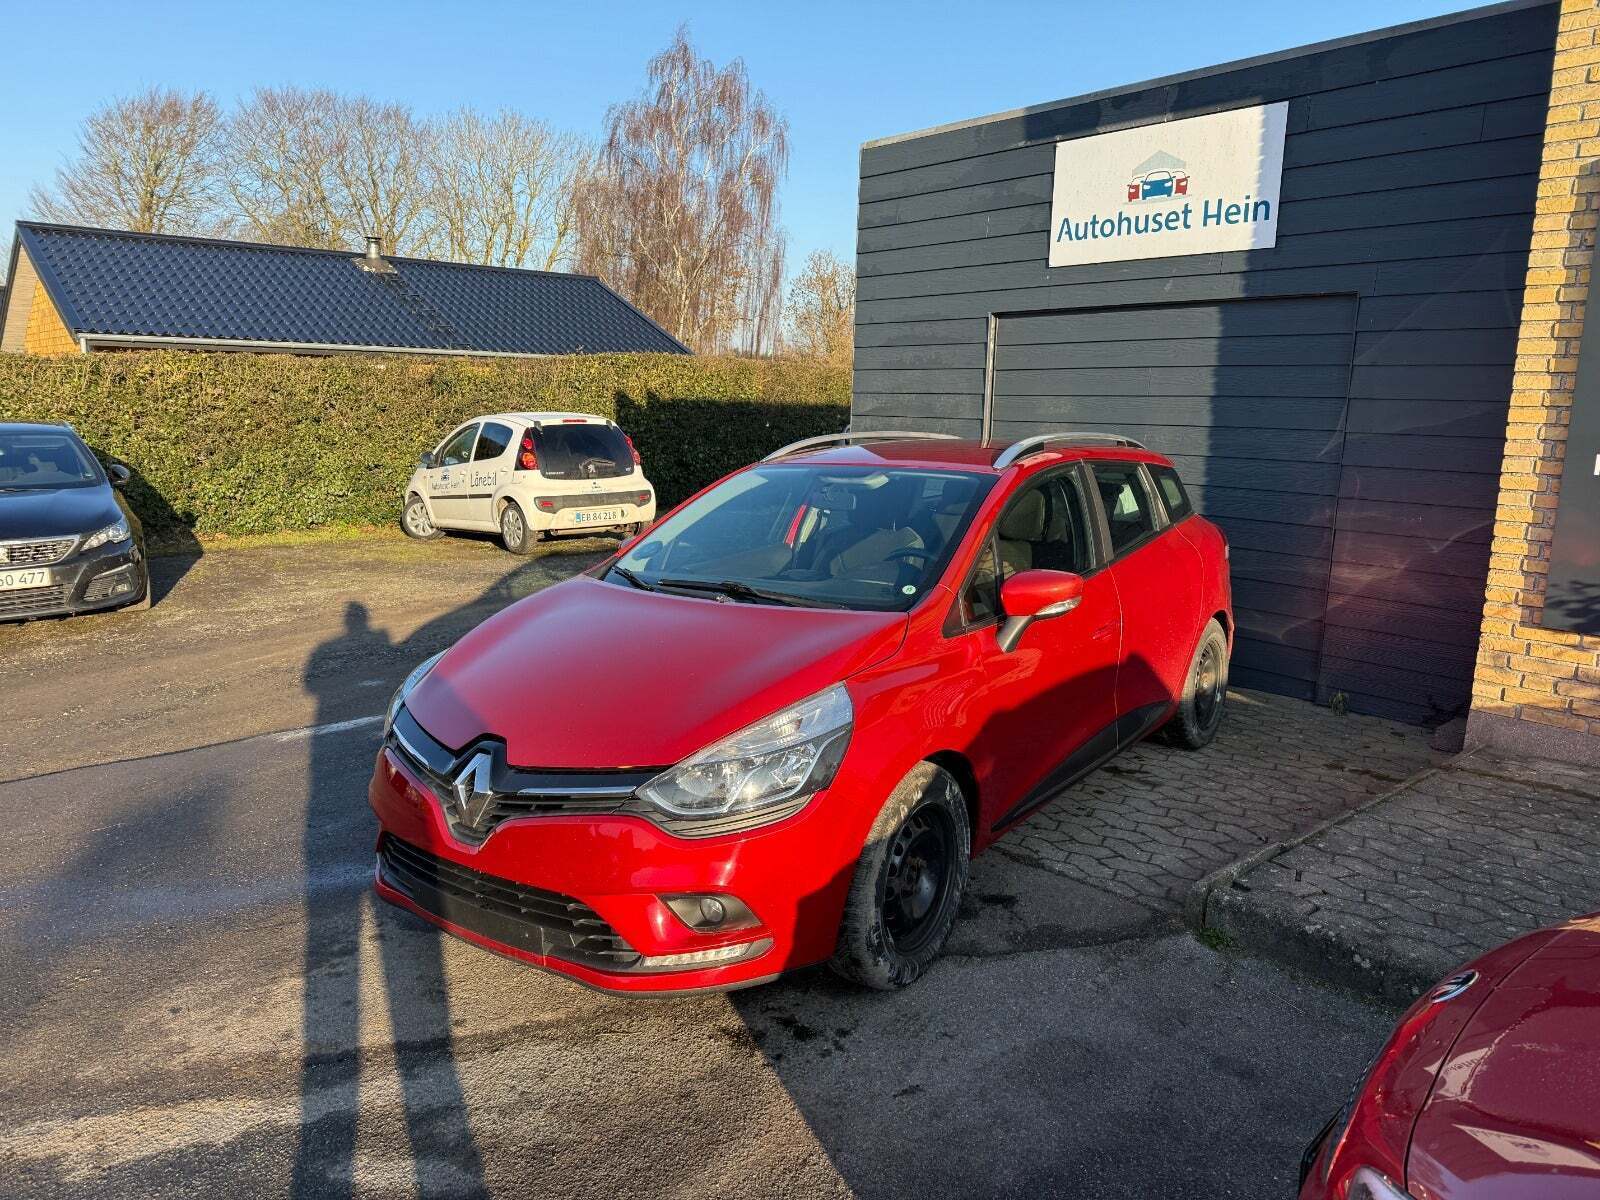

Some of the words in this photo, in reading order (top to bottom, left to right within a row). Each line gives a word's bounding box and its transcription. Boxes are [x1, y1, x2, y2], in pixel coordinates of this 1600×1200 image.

[1056, 203, 1192, 243] Autohuset
[1202, 195, 1270, 227] Hein
[470, 471, 497, 488] Lånebil
[592, 512, 602, 521] 84
[18, 571, 45, 584] 477
